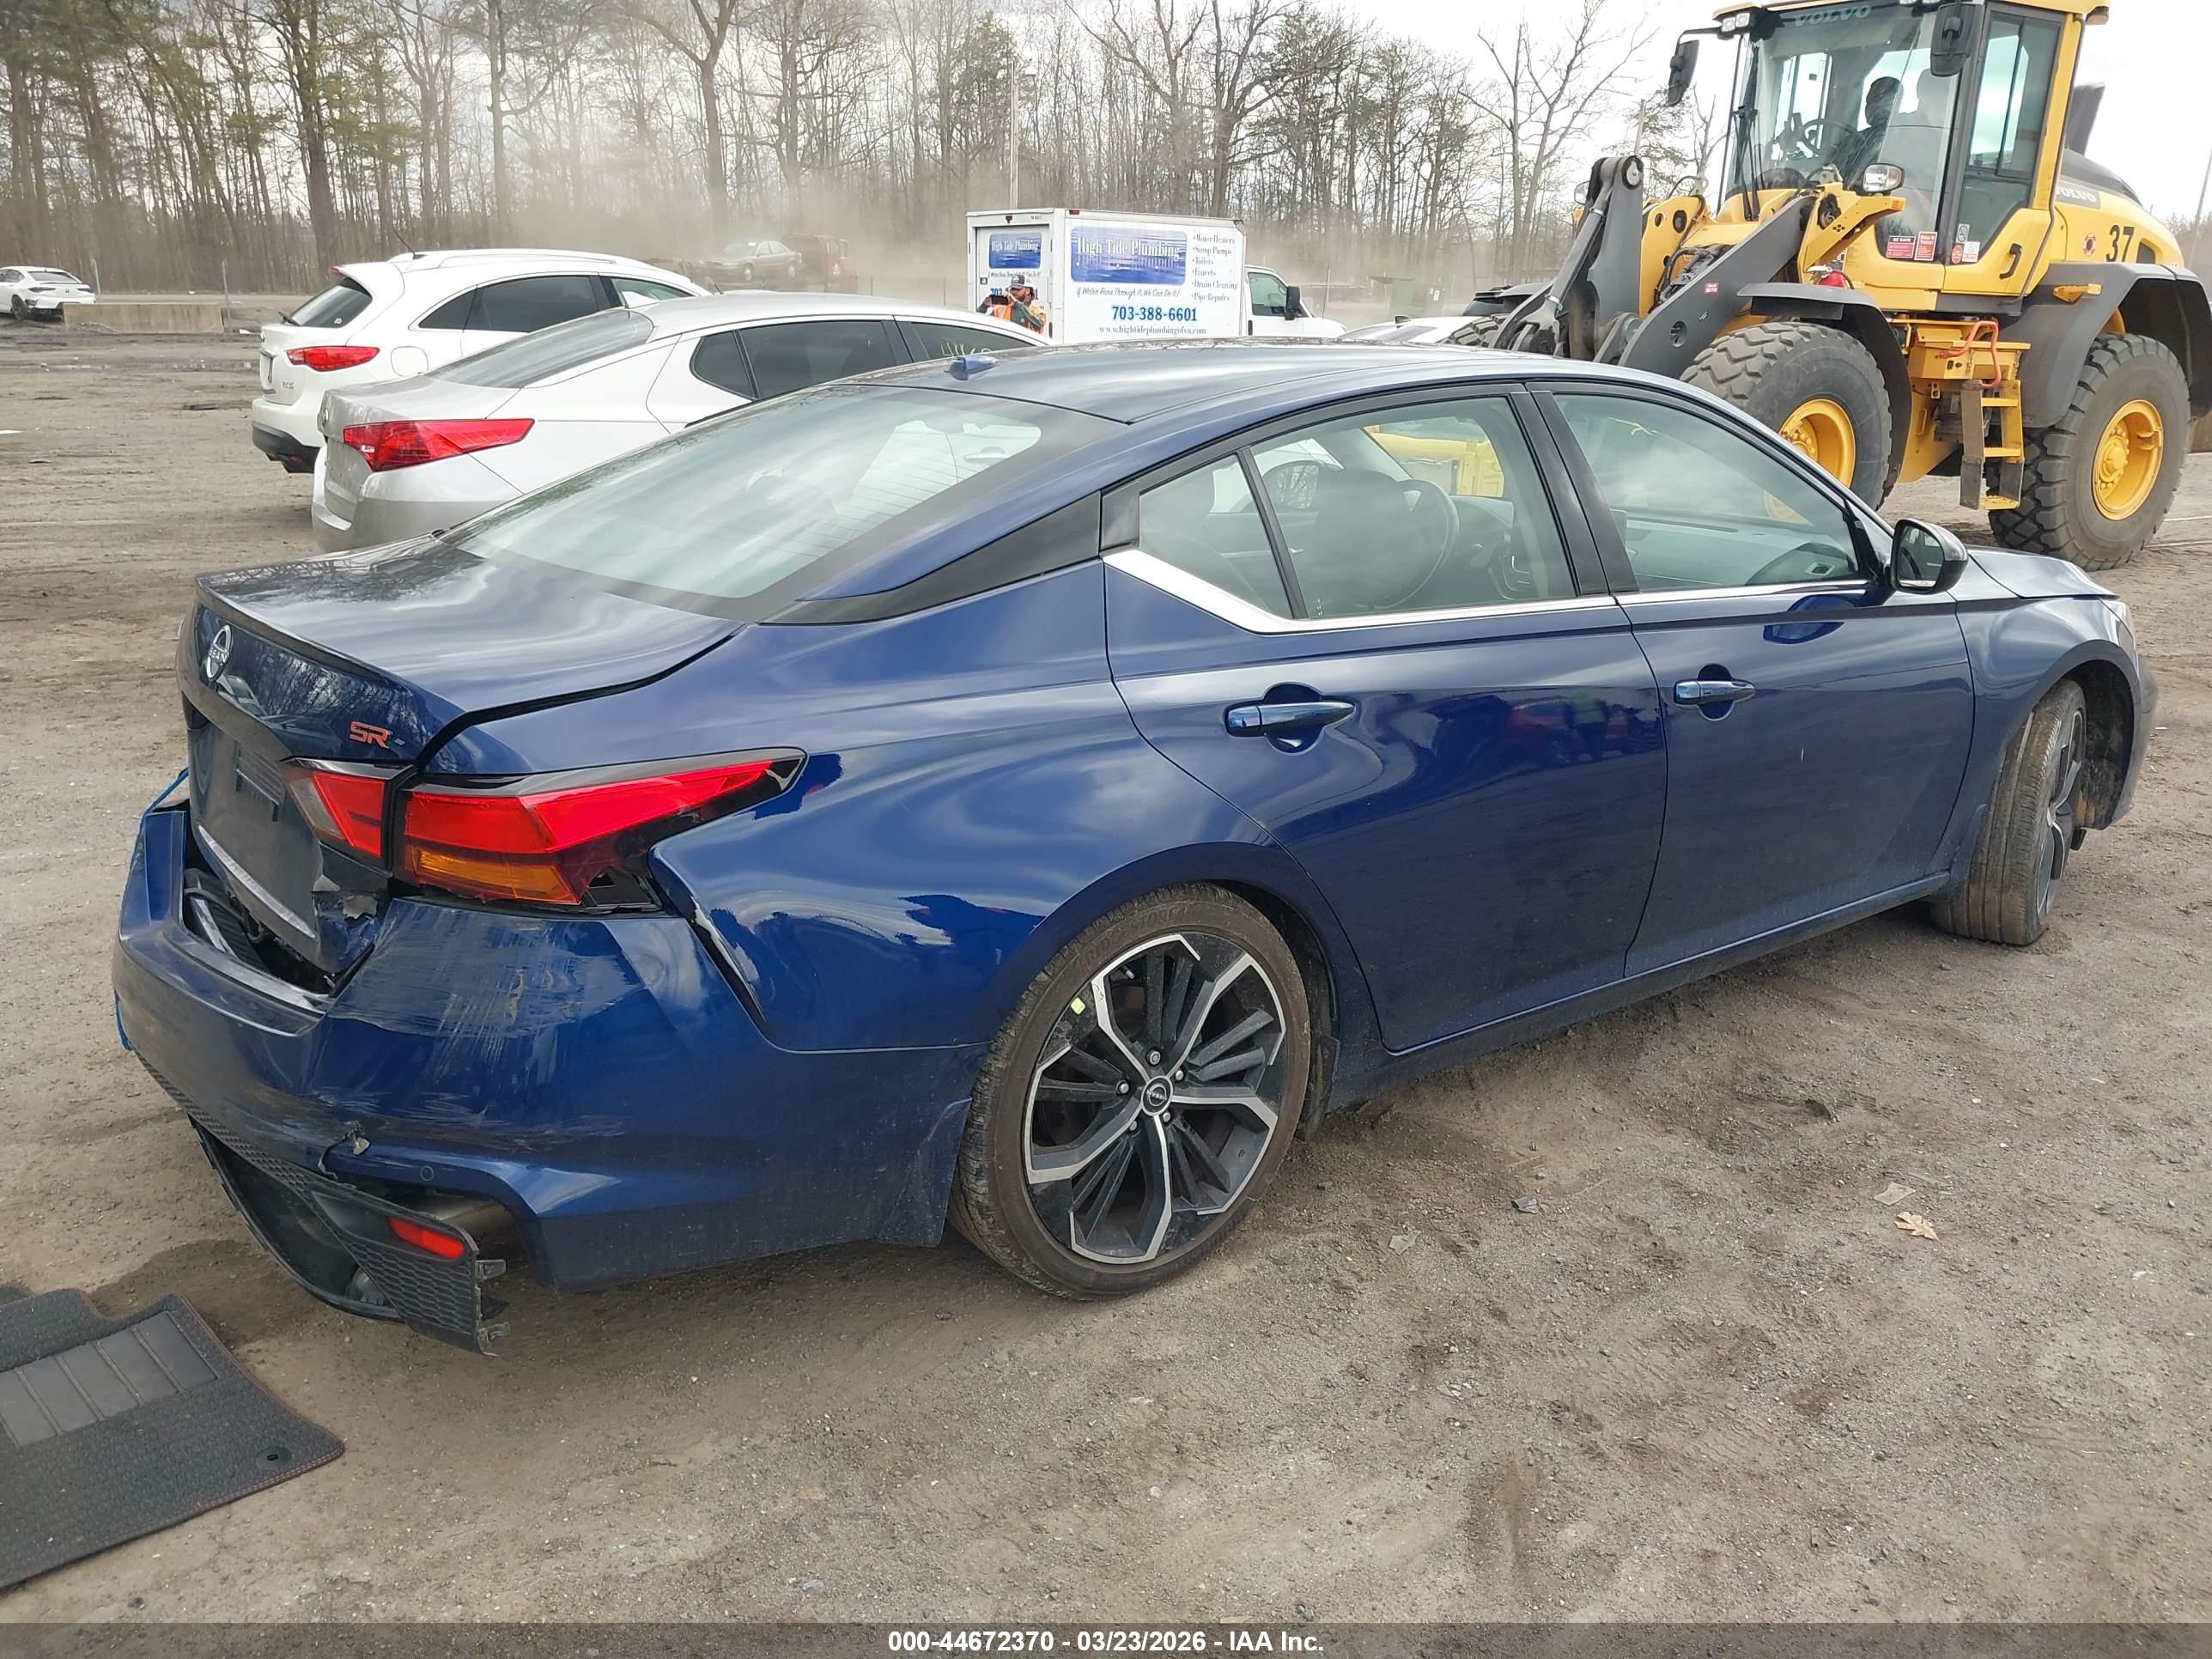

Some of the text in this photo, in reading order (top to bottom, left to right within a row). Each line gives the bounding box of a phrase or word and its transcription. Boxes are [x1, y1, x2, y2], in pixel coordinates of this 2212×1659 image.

[1794, 5, 1870, 27] VOLVO
[1077, 237, 1180, 261] High Tide Plumbing
[2106, 224, 2135, 262] 37
[1213, 281, 1237, 290] Cleaning
[1112, 306, 1197, 321] 703-388-6601
[349, 721, 389, 748] SR
